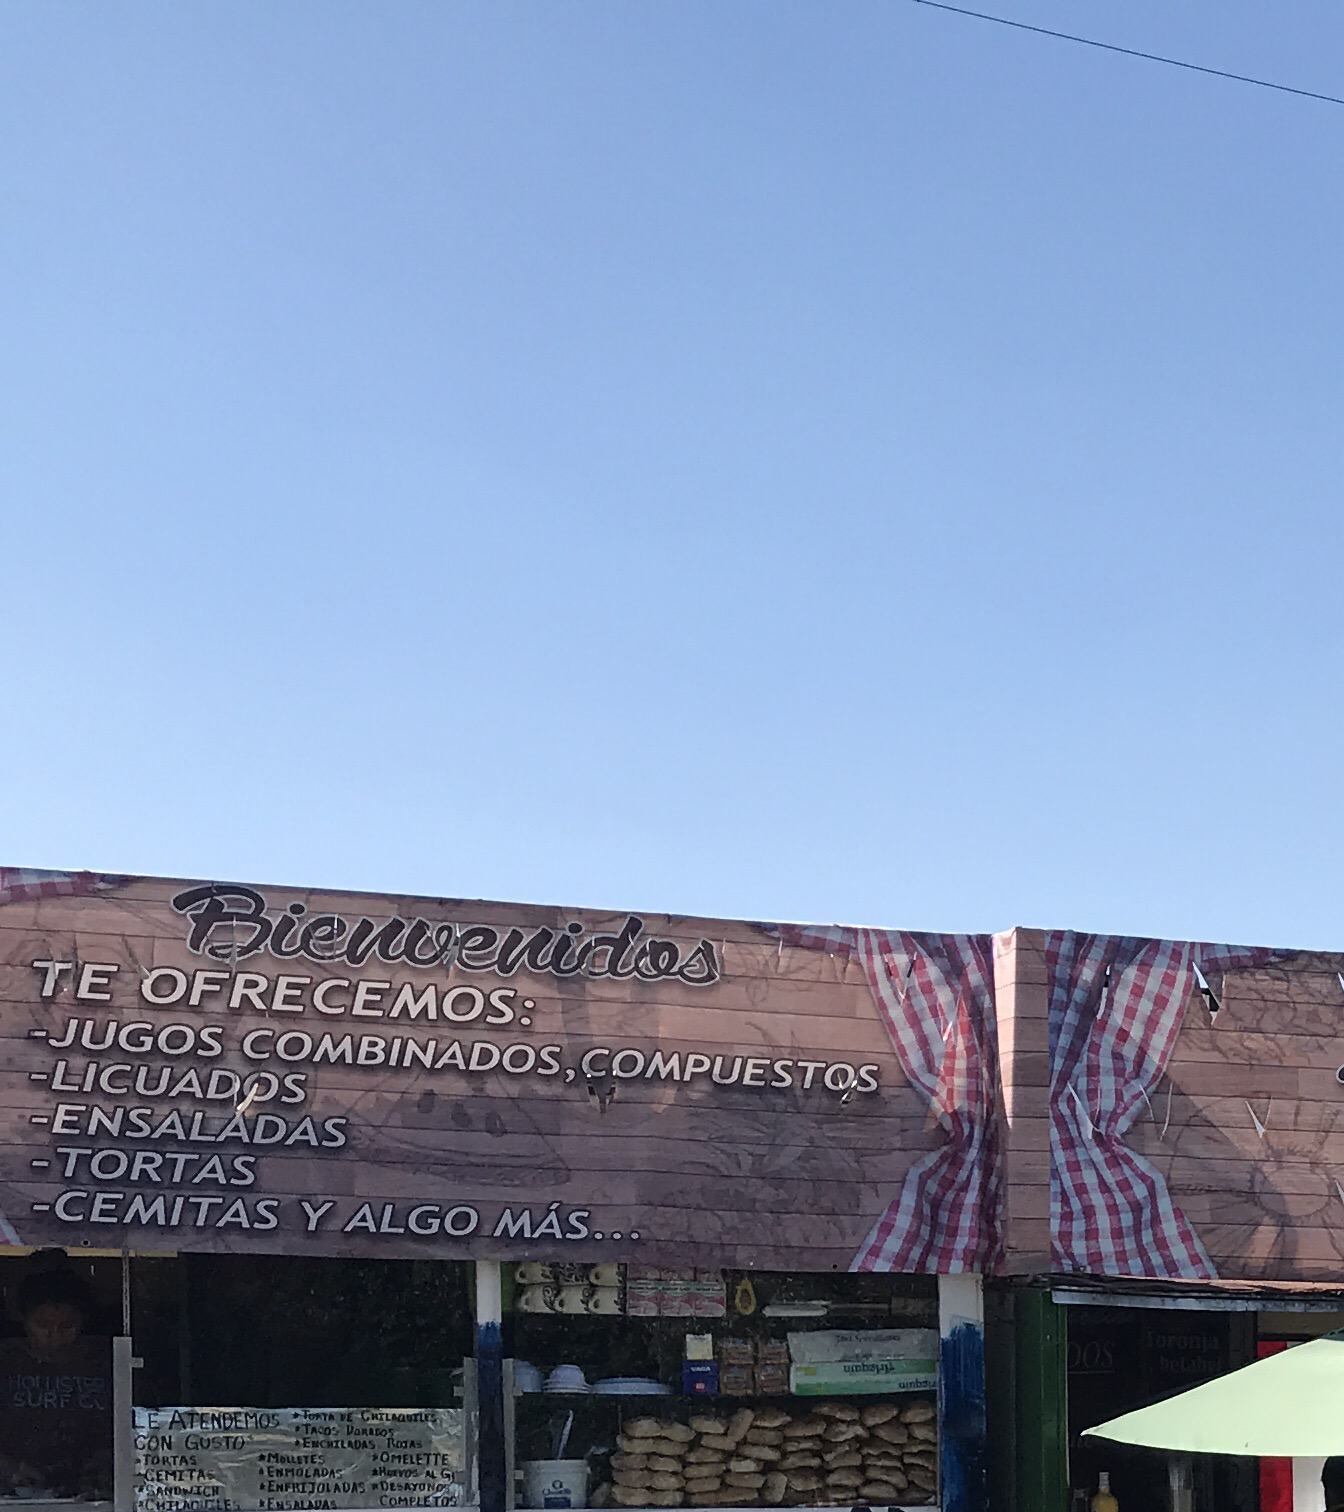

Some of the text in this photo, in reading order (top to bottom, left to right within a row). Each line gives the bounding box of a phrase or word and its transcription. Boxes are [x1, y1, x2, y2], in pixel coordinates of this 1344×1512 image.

[170, 884, 720, 986] Bienvenidos
[32, 959, 536, 1026] TE OFRECEMOS:
[300, 1201, 334, 1232] Y
[344, 1203, 479, 1237] ALGO
[493, 1202, 640, 1240] MÁS...
[131, 1408, 280, 1430] LE ATENDEMOS
[134, 1433, 246, 1451] CON GUSTO
[143, 1453, 197, 1467] TORTAS
[380, 1451, 450, 1466] OMELETTE
